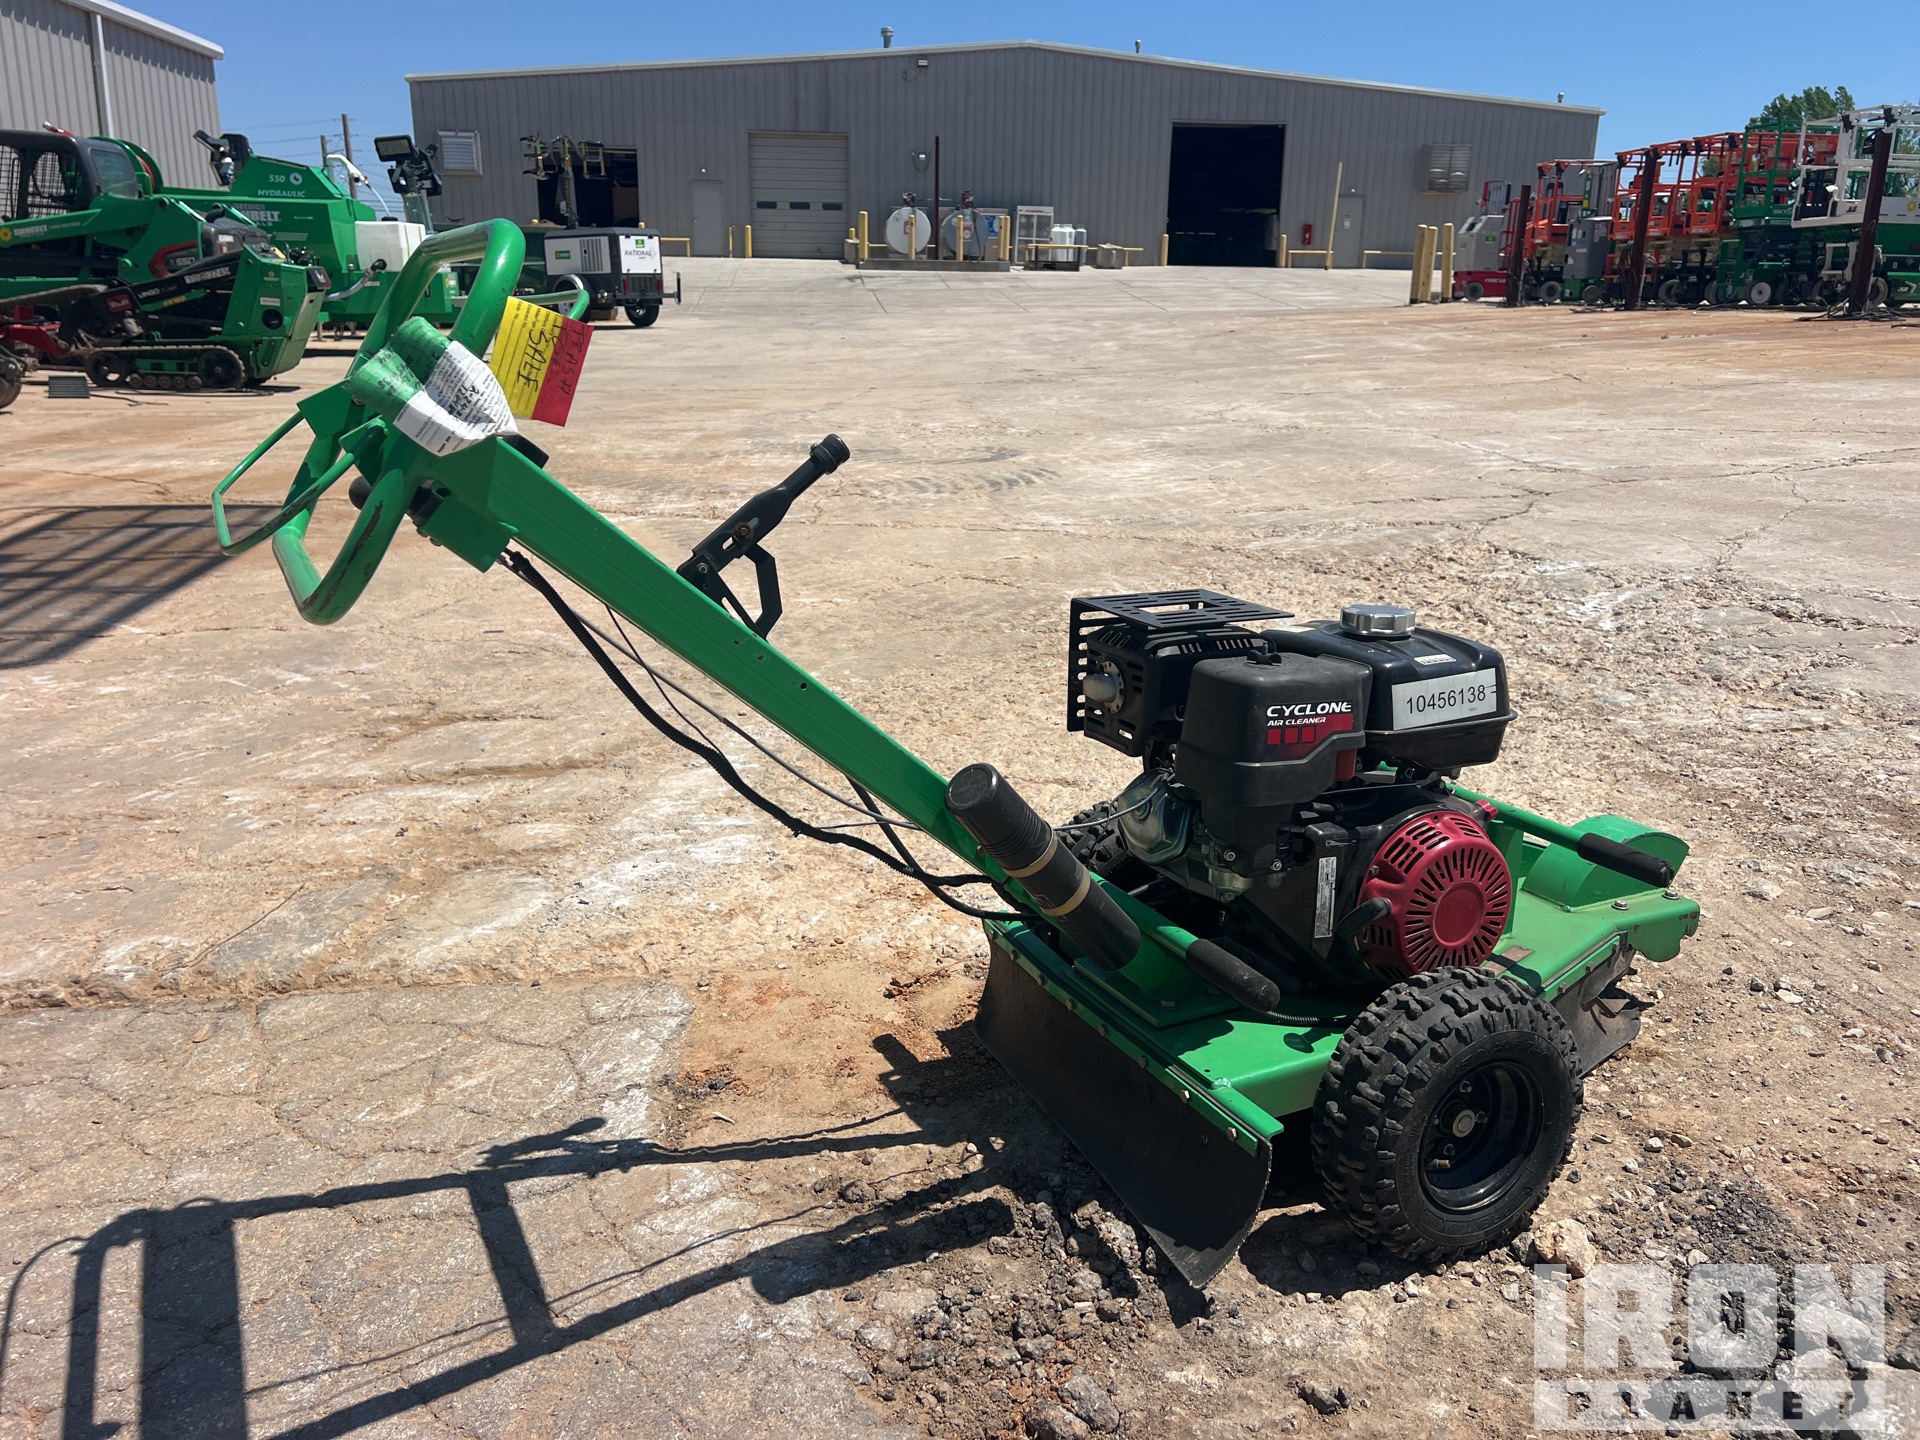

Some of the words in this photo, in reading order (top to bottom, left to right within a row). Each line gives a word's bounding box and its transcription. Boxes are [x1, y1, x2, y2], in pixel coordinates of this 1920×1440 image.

[258, 189, 305, 198] HYDRAULIC
[517, 329, 549, 392] SALE
[1406, 684, 1486, 715] 10456138
[1266, 702, 1352, 718] CYCLONE
[1267, 719, 1283, 727] AIR
[1285, 717, 1327, 726] CLEANER
